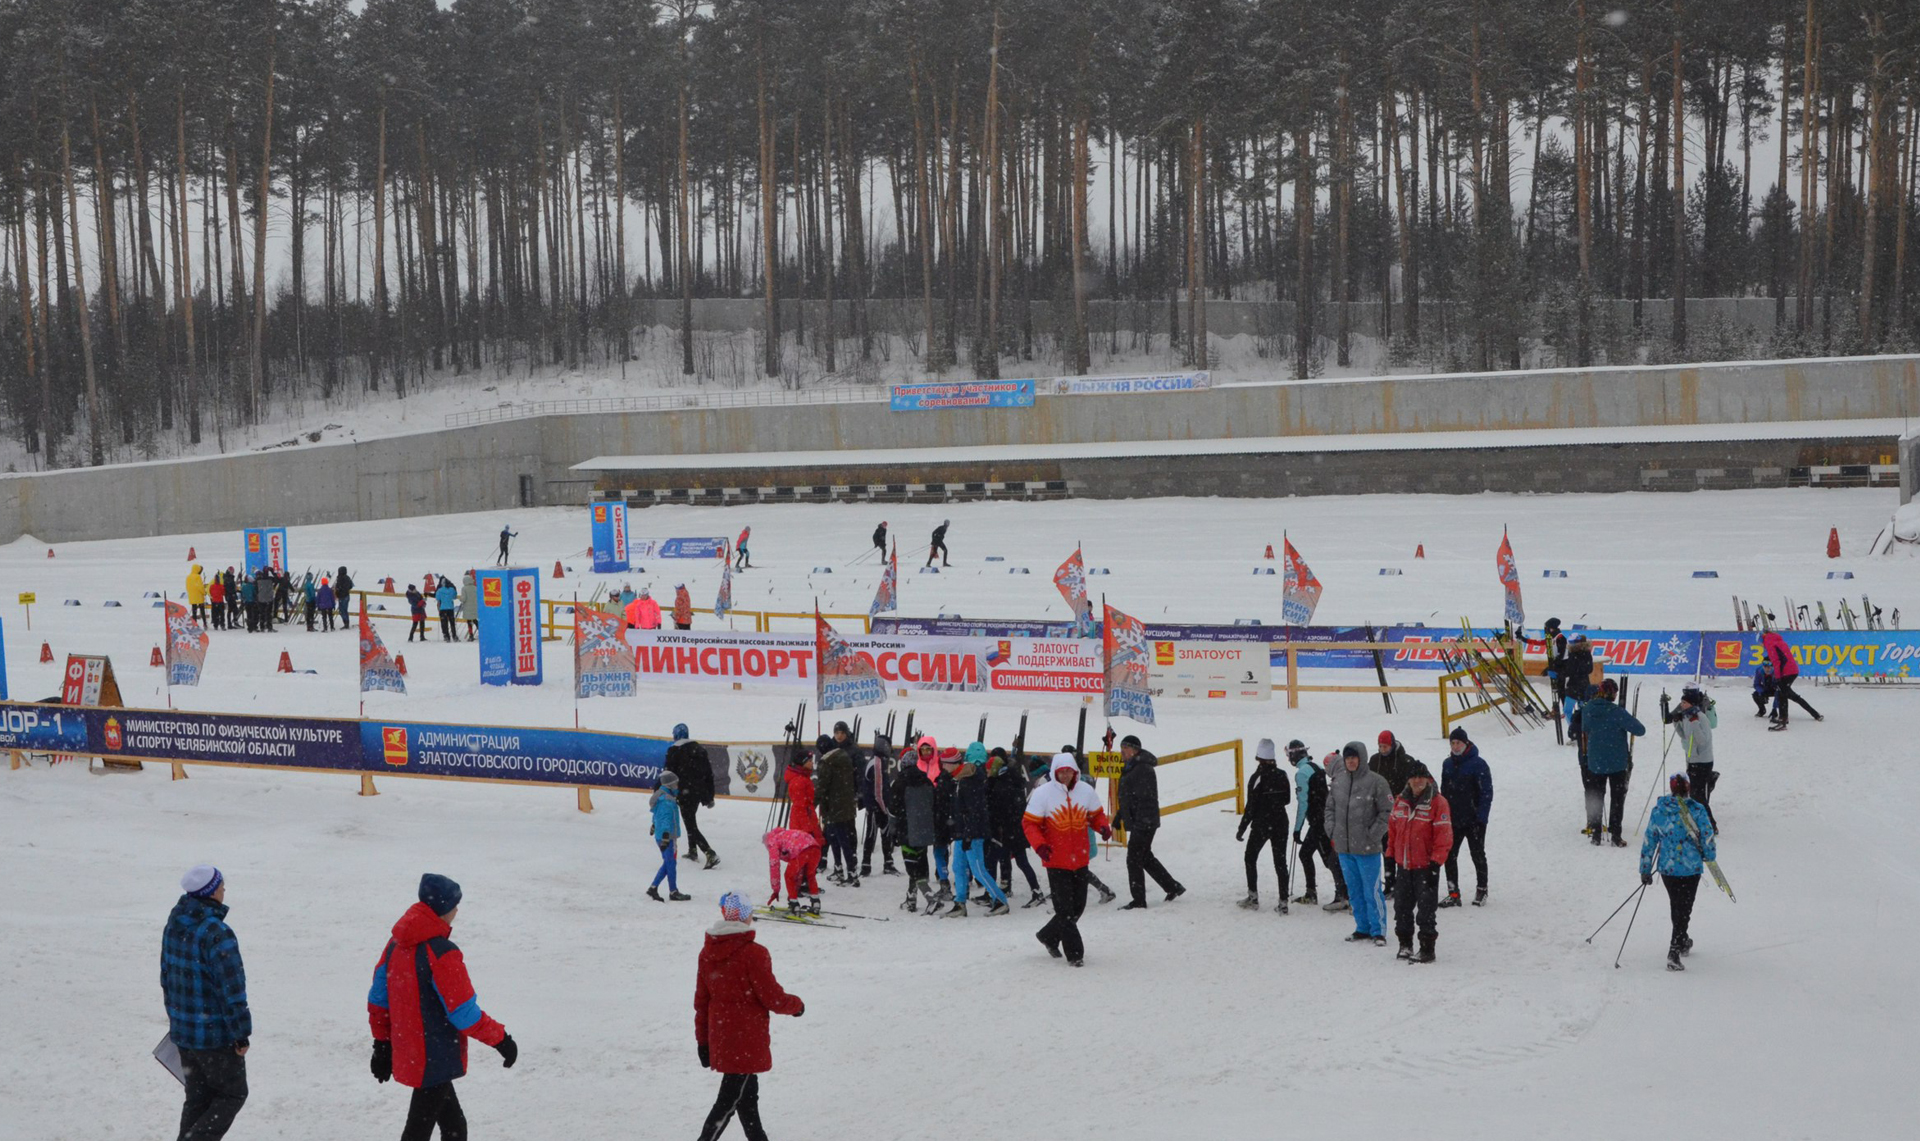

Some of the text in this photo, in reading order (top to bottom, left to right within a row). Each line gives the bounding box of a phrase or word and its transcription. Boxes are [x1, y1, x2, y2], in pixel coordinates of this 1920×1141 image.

[894, 383, 1017, 397] Приветствуем участников
[1073, 378, 1194, 392] ЛЫЖНЯ РОССИИ
[614, 507, 625, 560] СТАРТ
[271, 535, 282, 576] СТА
[516, 580, 535, 673] ФИНИШ
[681, 636, 738, 646] Всероссийская
[739, 638, 775, 646] массовая
[1032, 643, 1080, 655] ЗЛАТОУСТ
[592, 647, 617, 656] 2018
[1178, 649, 1242, 660] ЗЛАТОУСТ
[1749, 644, 1880, 666] ЗАТОУСТ
[1017, 655, 1096, 667] ПОДДЕРЖИВАЕТ
[1125, 661, 1146, 674] 201
[580, 672, 631, 683] ЛЫЖНЯ
[997, 673, 1071, 689] ОЛИМПИЙЦЕВ
[581, 682, 631, 694] РОССИИ
[824, 678, 879, 695] ЛЫЖНЯ
[825, 689, 880, 705] РОССИИ
[126, 719, 343, 744] МИНИСТЕРСТВО ПО ФИЗИЧЕСКОЙ КУЛЬТУРЕ
[127, 735, 296, 757] И СПОРТУ ЧЕЛЯБИНСКОЙ ОБЛАСТИ
[418, 731, 520, 750] АДМИНИСТРАЦИЯ
[419, 751, 661, 780] ЗЛАТОУСТОВСКОГО ГОРОДСКОГО ОКРУГ
